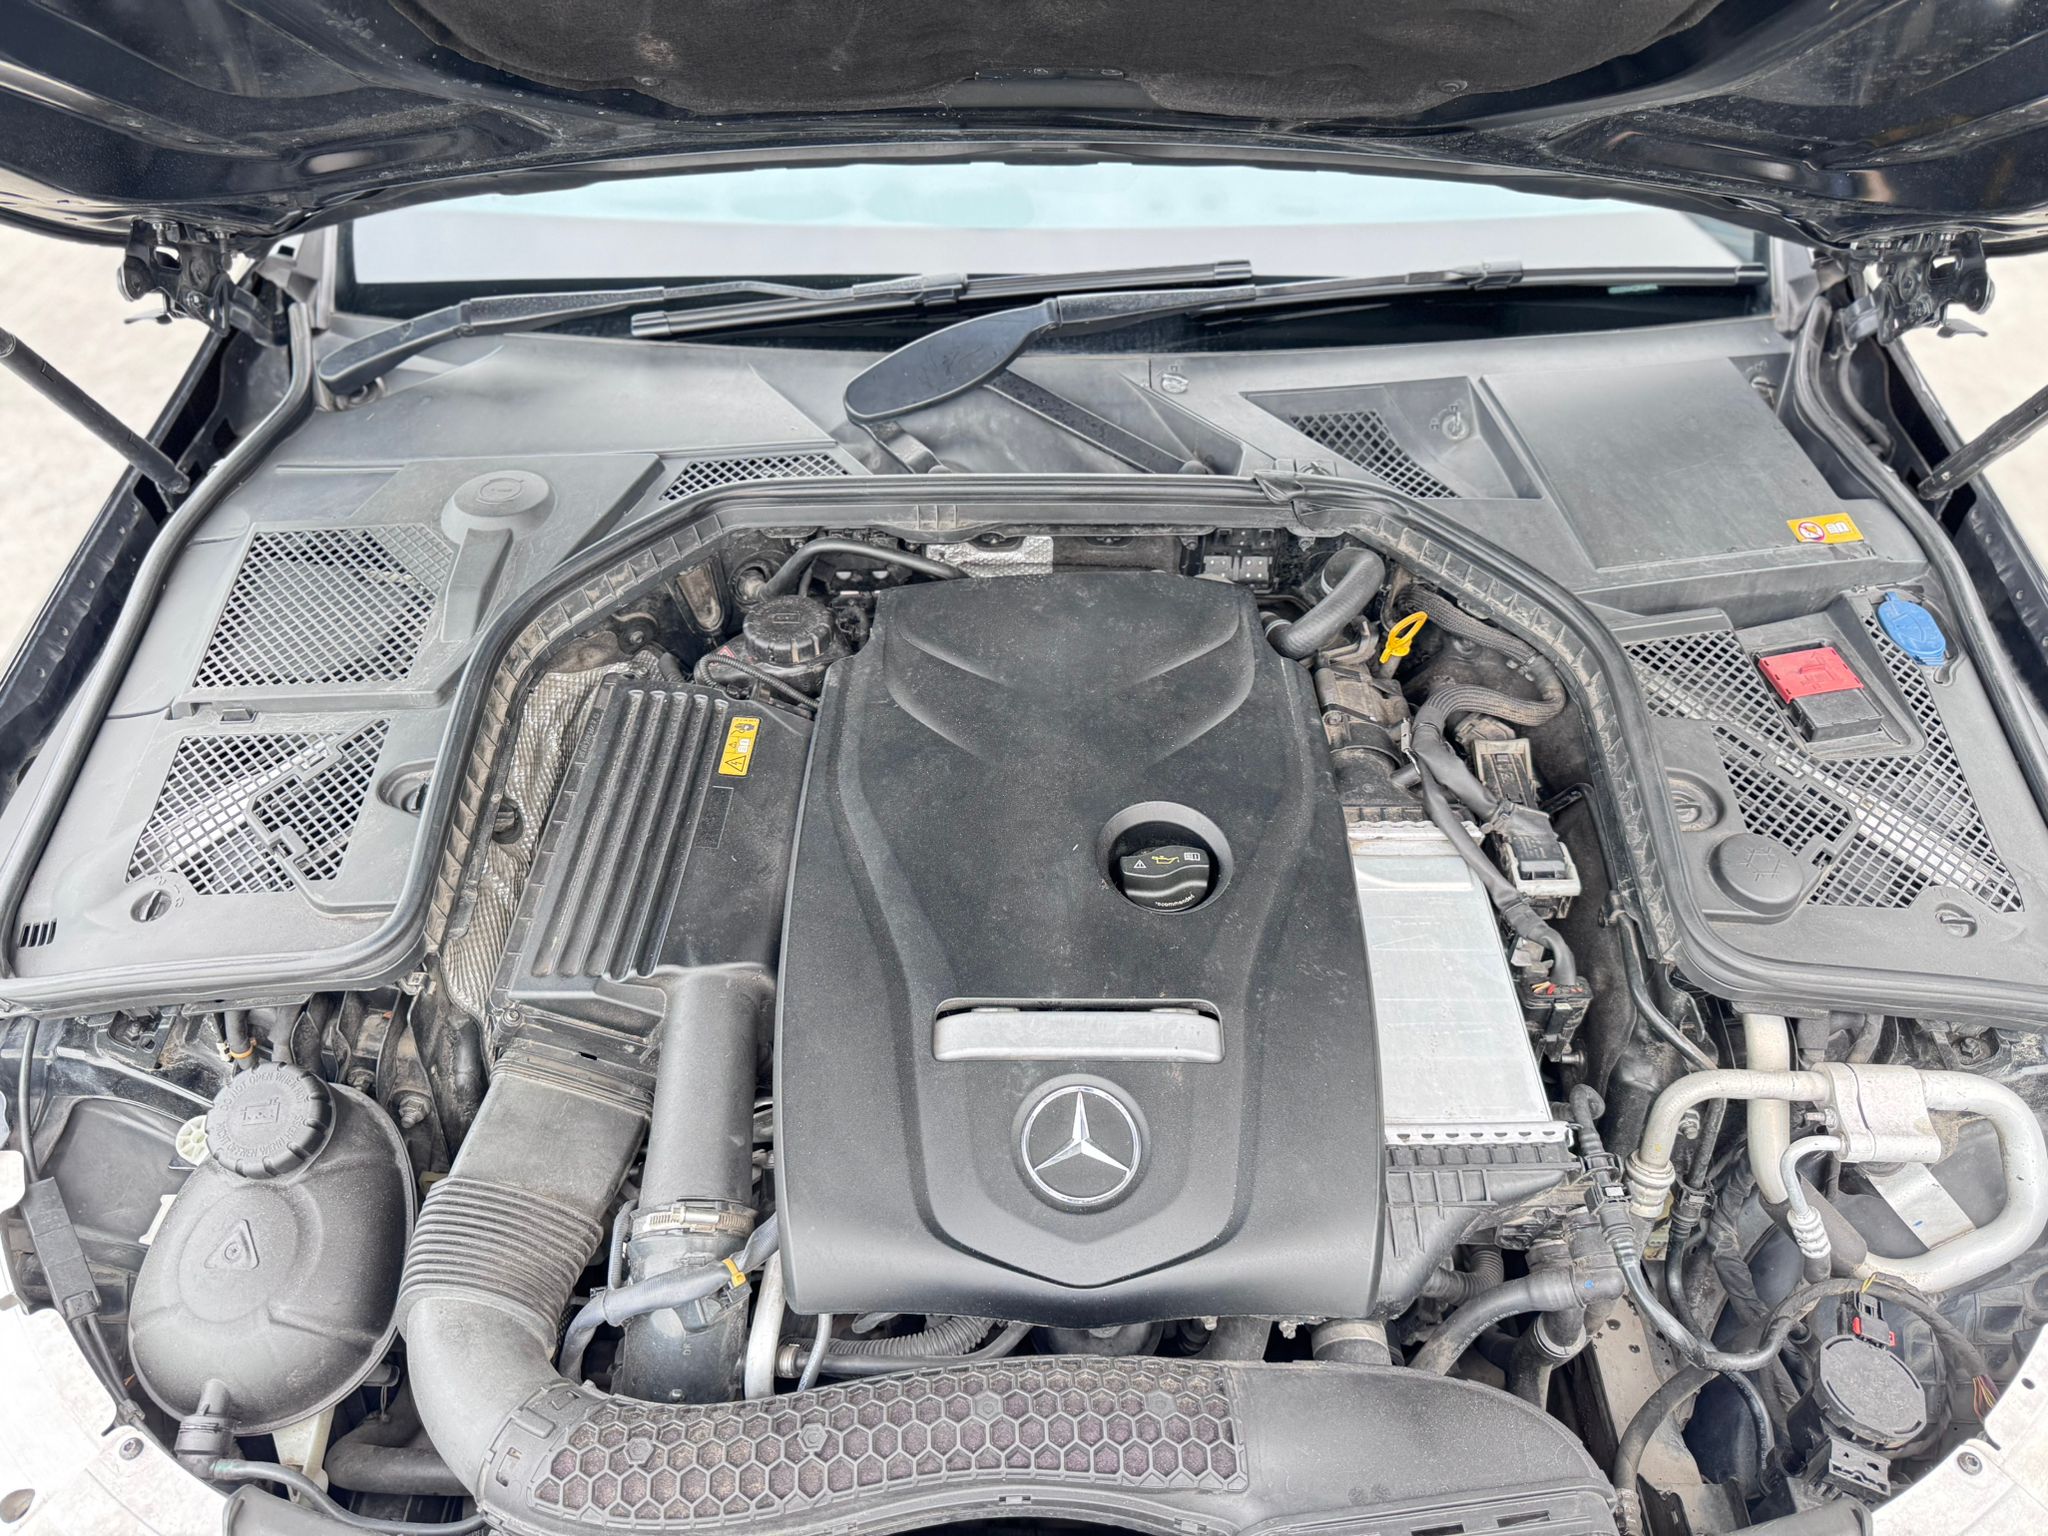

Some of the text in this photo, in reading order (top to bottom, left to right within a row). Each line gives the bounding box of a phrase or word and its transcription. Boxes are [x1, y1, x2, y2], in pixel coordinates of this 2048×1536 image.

[231, 1080, 248, 1100] NOT
[248, 1072, 273, 1085] OPEN
[275, 1072, 299, 1091] WHEN
